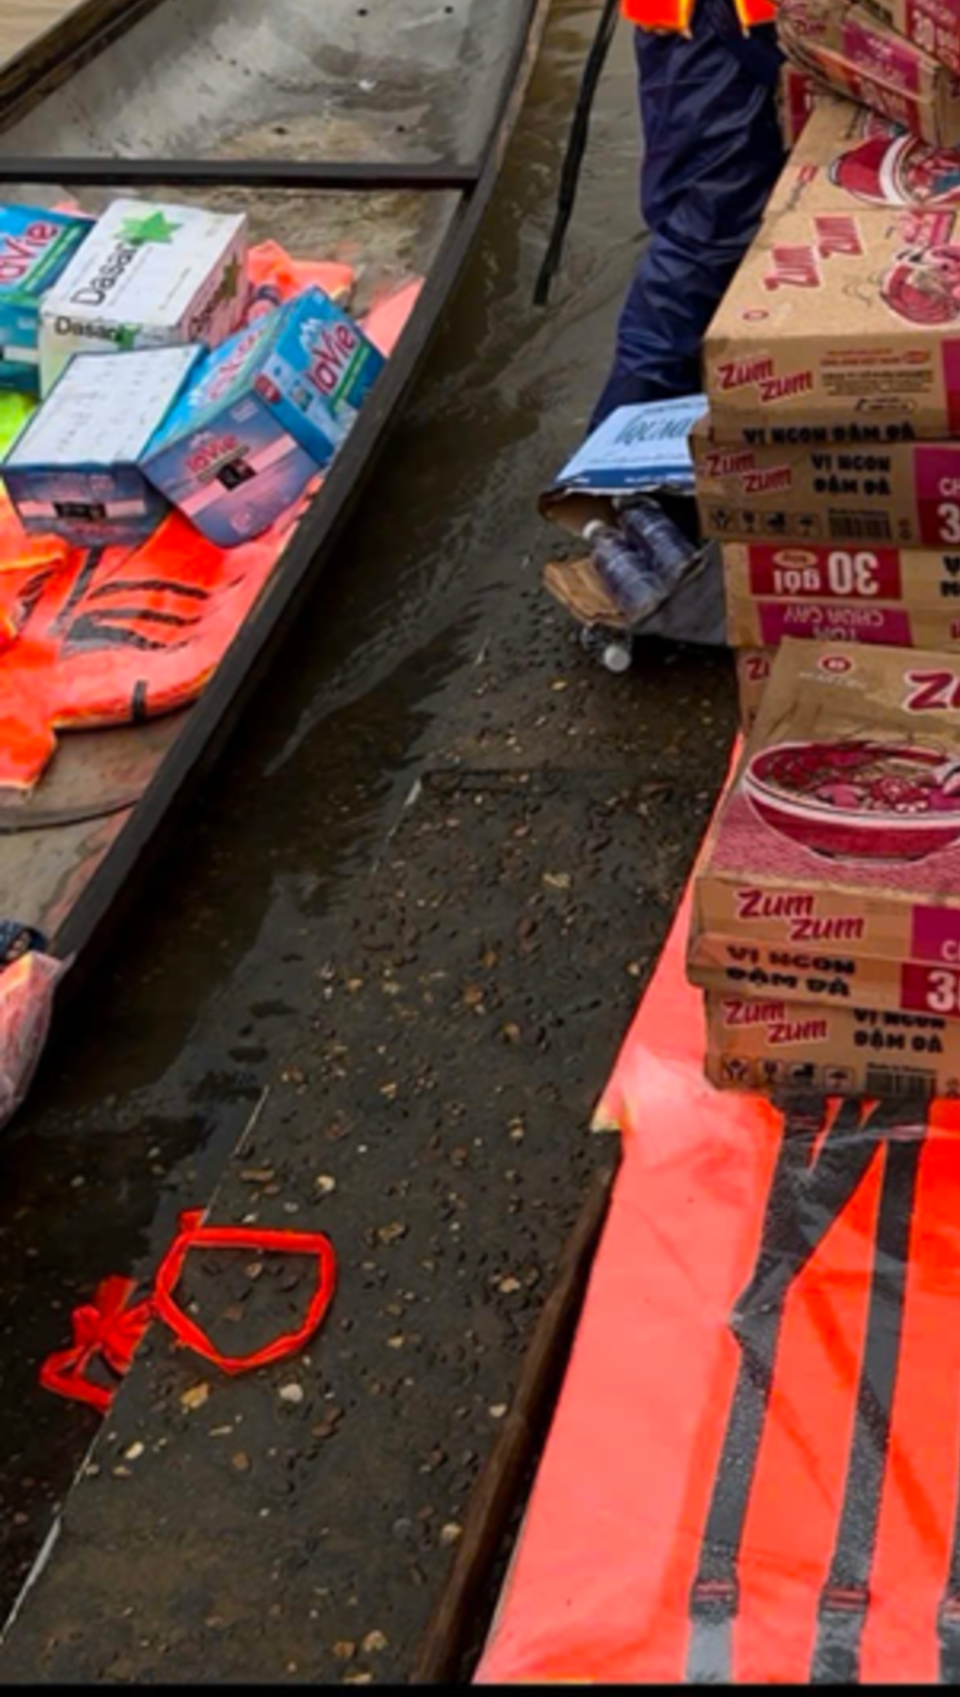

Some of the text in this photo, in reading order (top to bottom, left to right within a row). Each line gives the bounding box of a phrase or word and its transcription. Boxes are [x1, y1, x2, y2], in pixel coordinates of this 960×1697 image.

[771, 426, 826, 443] NGON
[838, 455, 890, 472] NGON
[773, 552, 880, 596] 30 gói
[784, 606, 884, 627] CHUA CAY
[769, 952, 856, 975] NGON
[853, 1029, 943, 1054] ĐẬM ĐÀ
